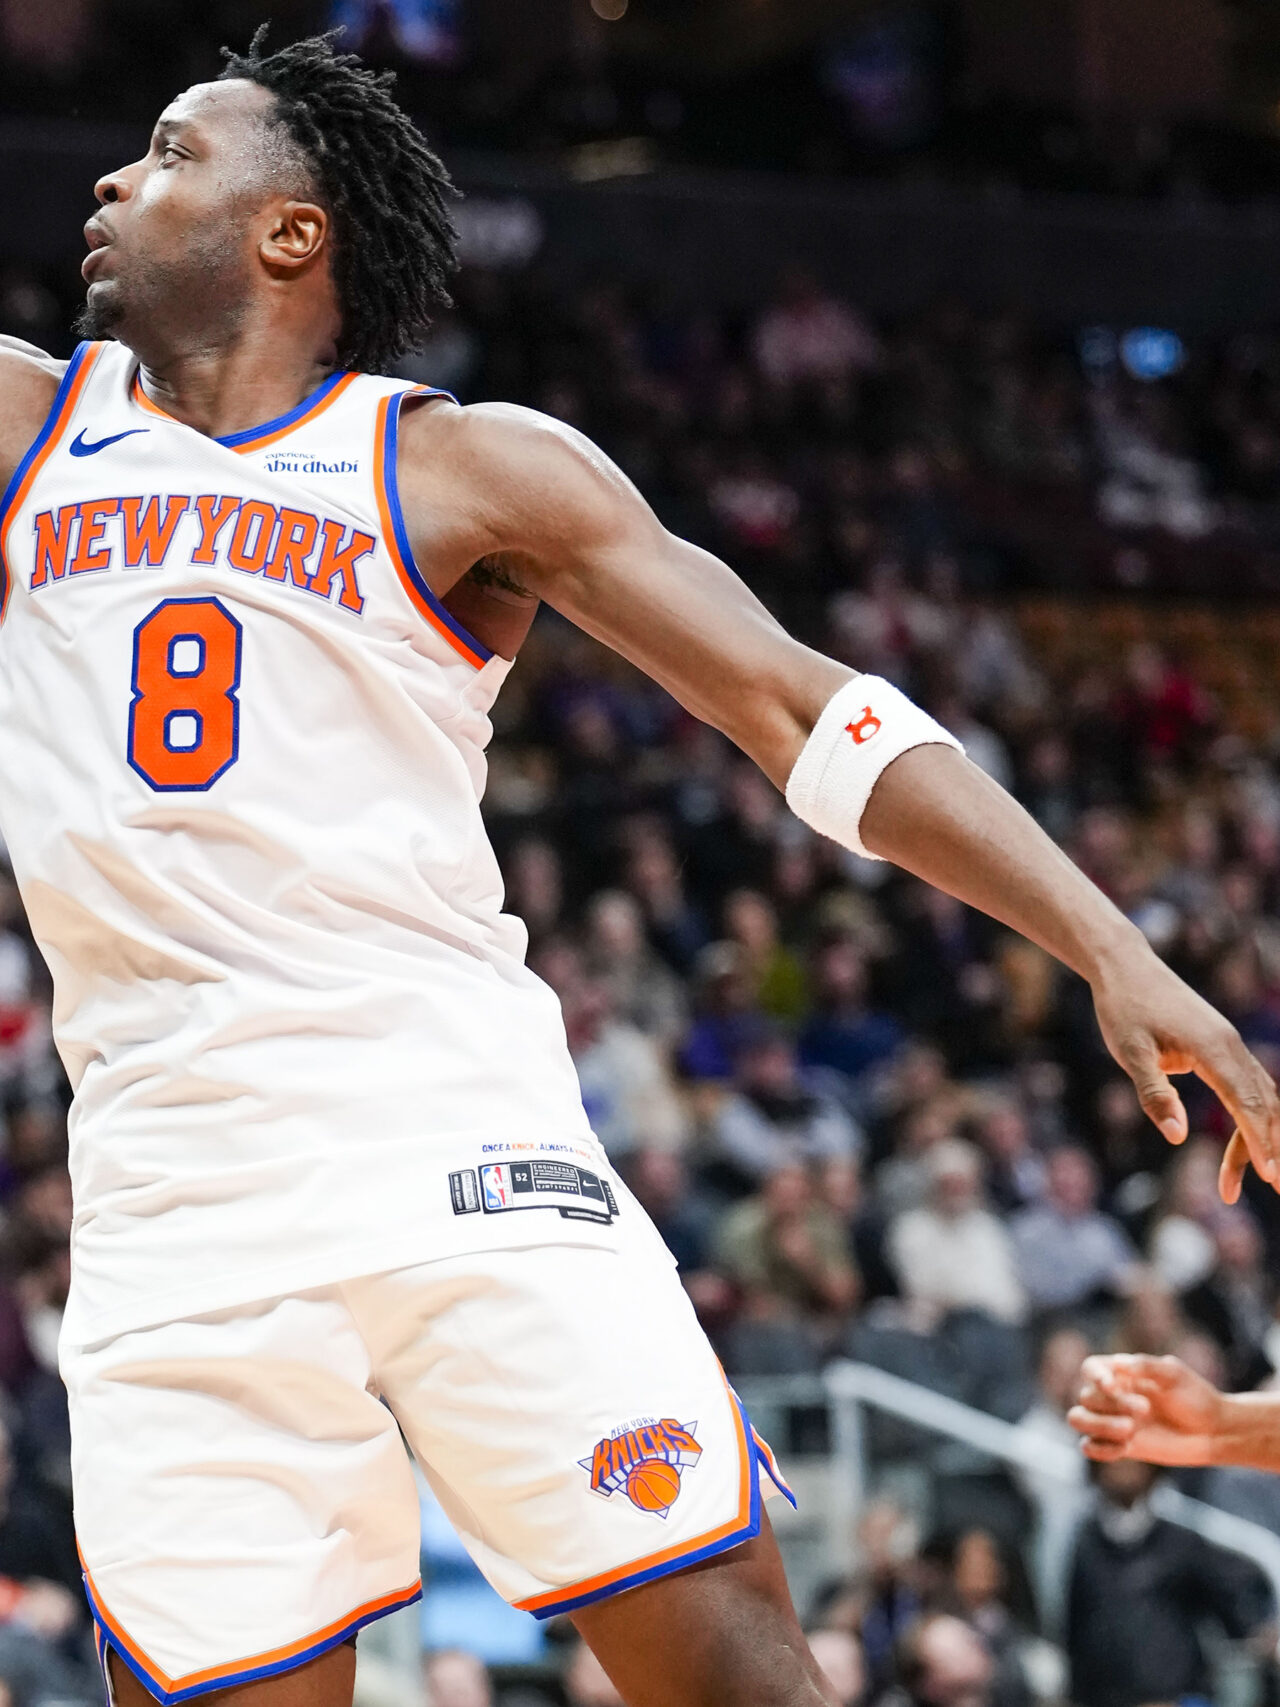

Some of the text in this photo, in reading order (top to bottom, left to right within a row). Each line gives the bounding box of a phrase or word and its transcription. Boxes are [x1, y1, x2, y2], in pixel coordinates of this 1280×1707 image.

[264, 459, 359, 473] abu dhabi
[30, 494, 376, 616] NEW YORK
[127, 596, 243, 792] 8
[844, 705, 882, 745] 8
[481, 1143, 504, 1153] ONCE
[505, 1143, 511, 1151] A
[539, 1143, 569, 1153] ALWAYS
[515, 1172, 528, 1182] 52
[610, 1416, 658, 1439] NEW YORK
[591, 1418, 703, 1494] KNICKS
